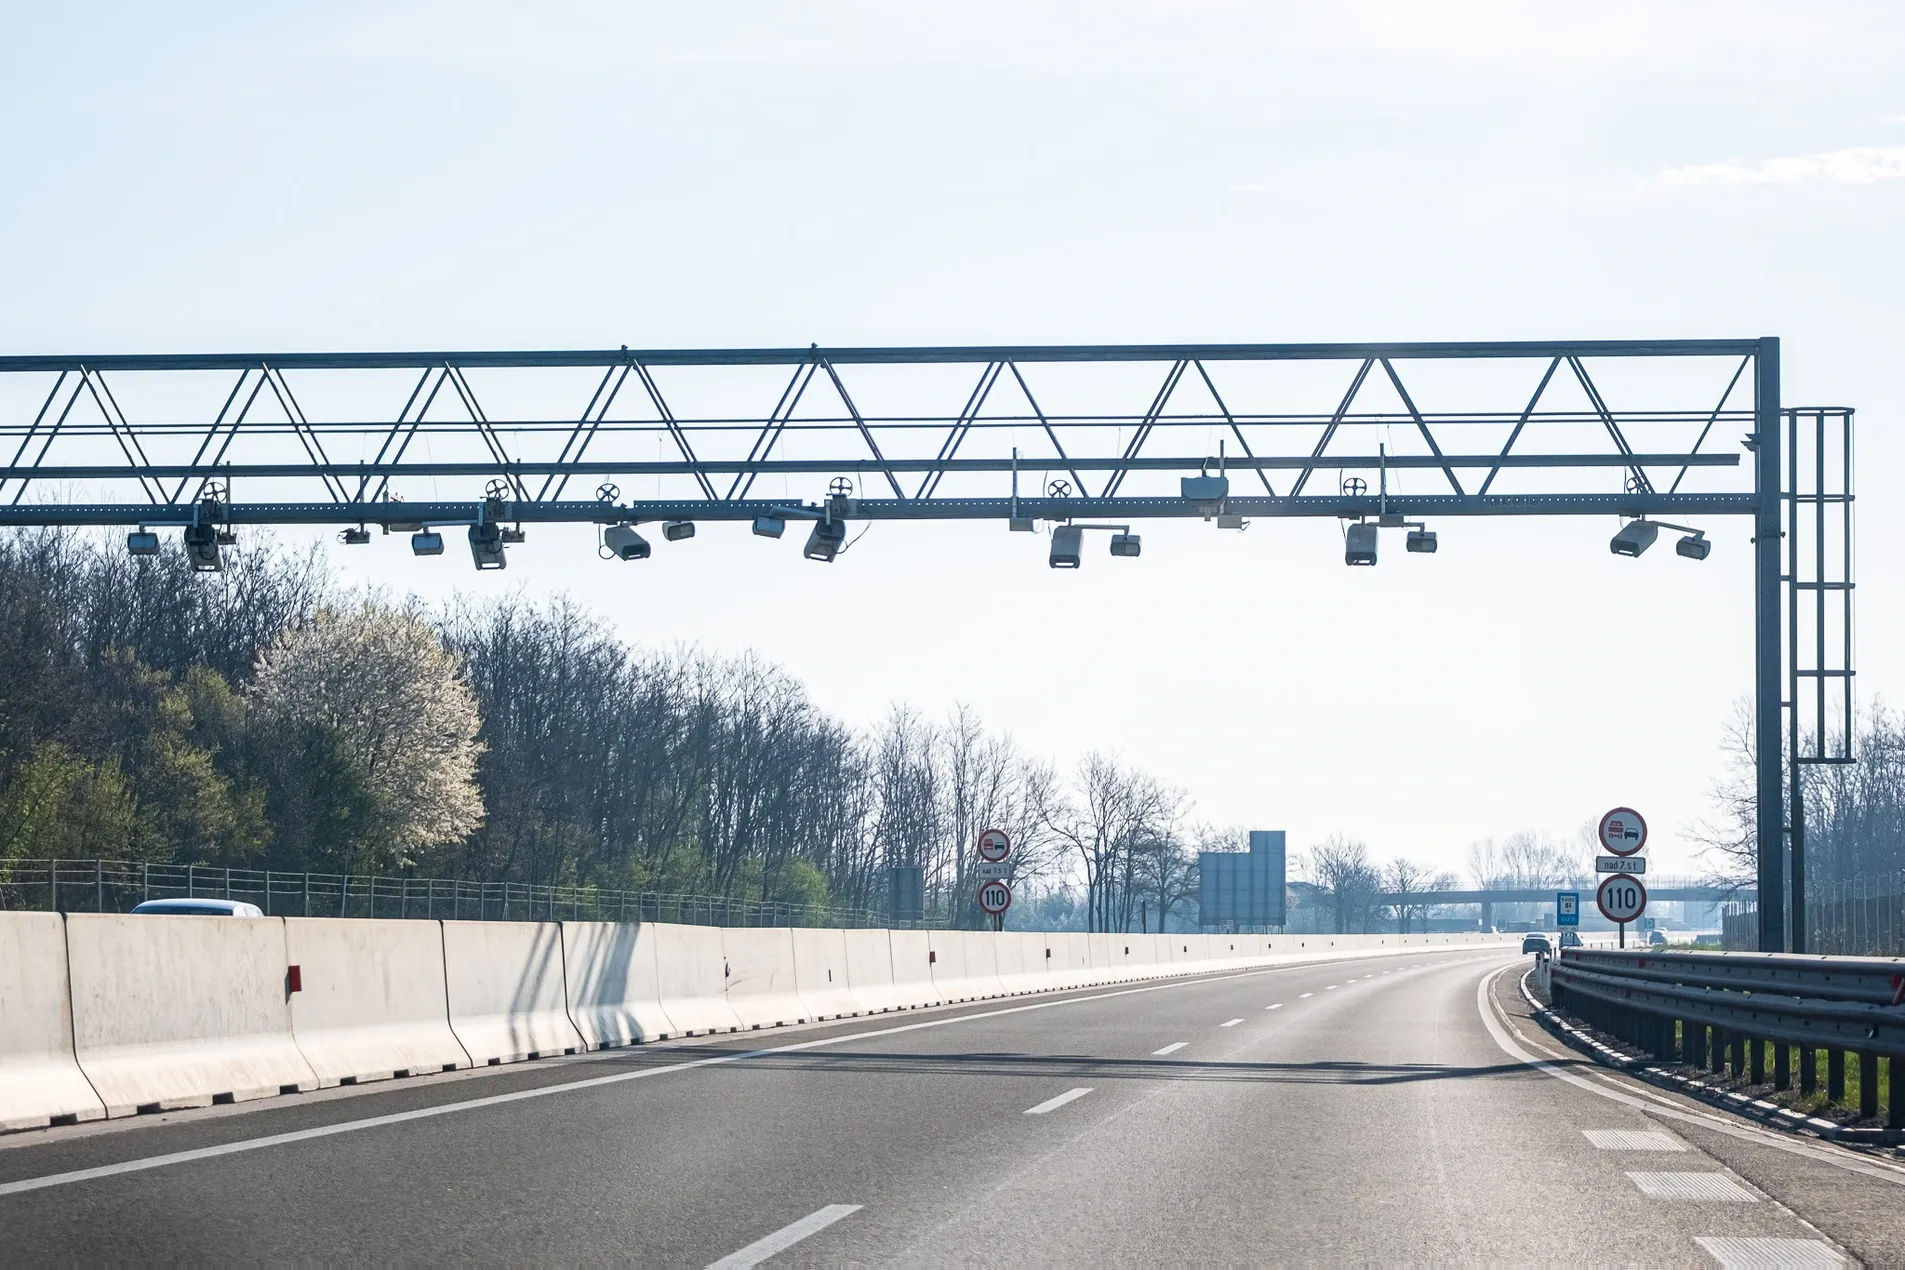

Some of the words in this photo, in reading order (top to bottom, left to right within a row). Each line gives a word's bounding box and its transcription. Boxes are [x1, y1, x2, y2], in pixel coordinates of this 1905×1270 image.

[1604, 861, 1618, 870] nad
[985, 890, 1005, 906] 110
[1607, 888, 1636, 909] 110
